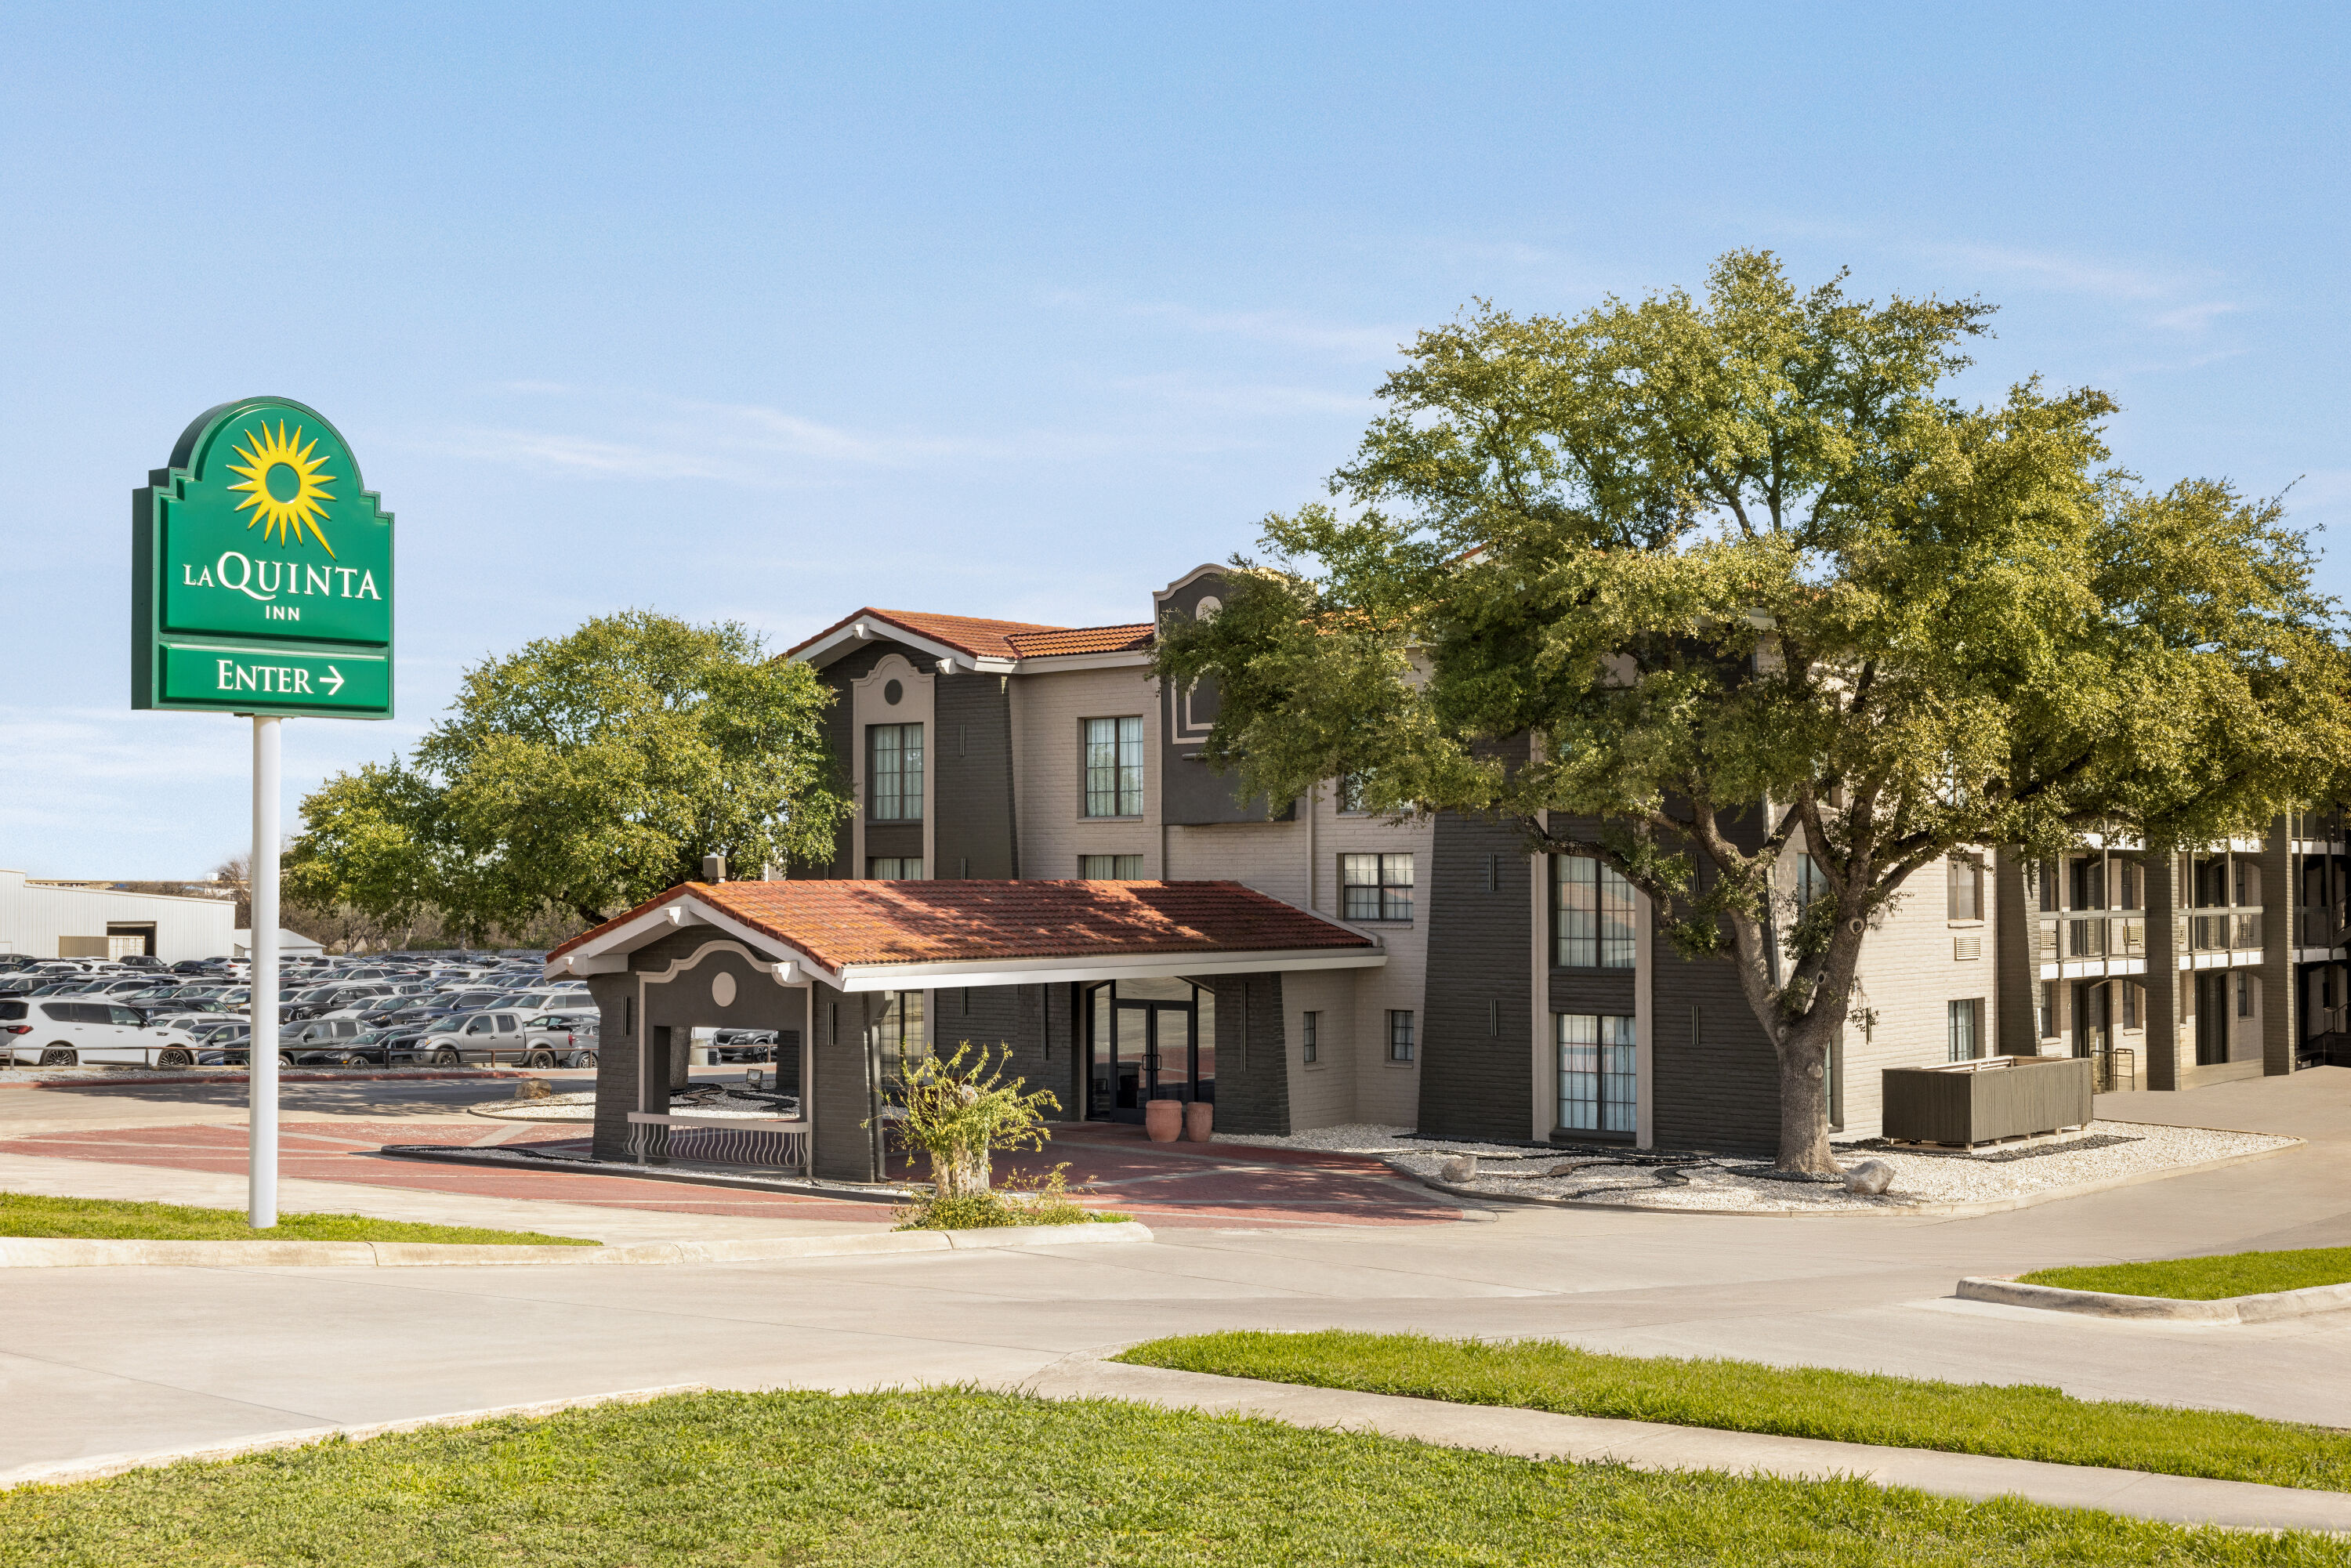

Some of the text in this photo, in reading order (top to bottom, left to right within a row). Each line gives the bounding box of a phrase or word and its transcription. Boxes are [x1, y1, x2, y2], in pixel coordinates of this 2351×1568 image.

[216, 551, 382, 601] QUINTA
[265, 605, 299, 621] INN
[216, 659, 314, 695] ENTER
